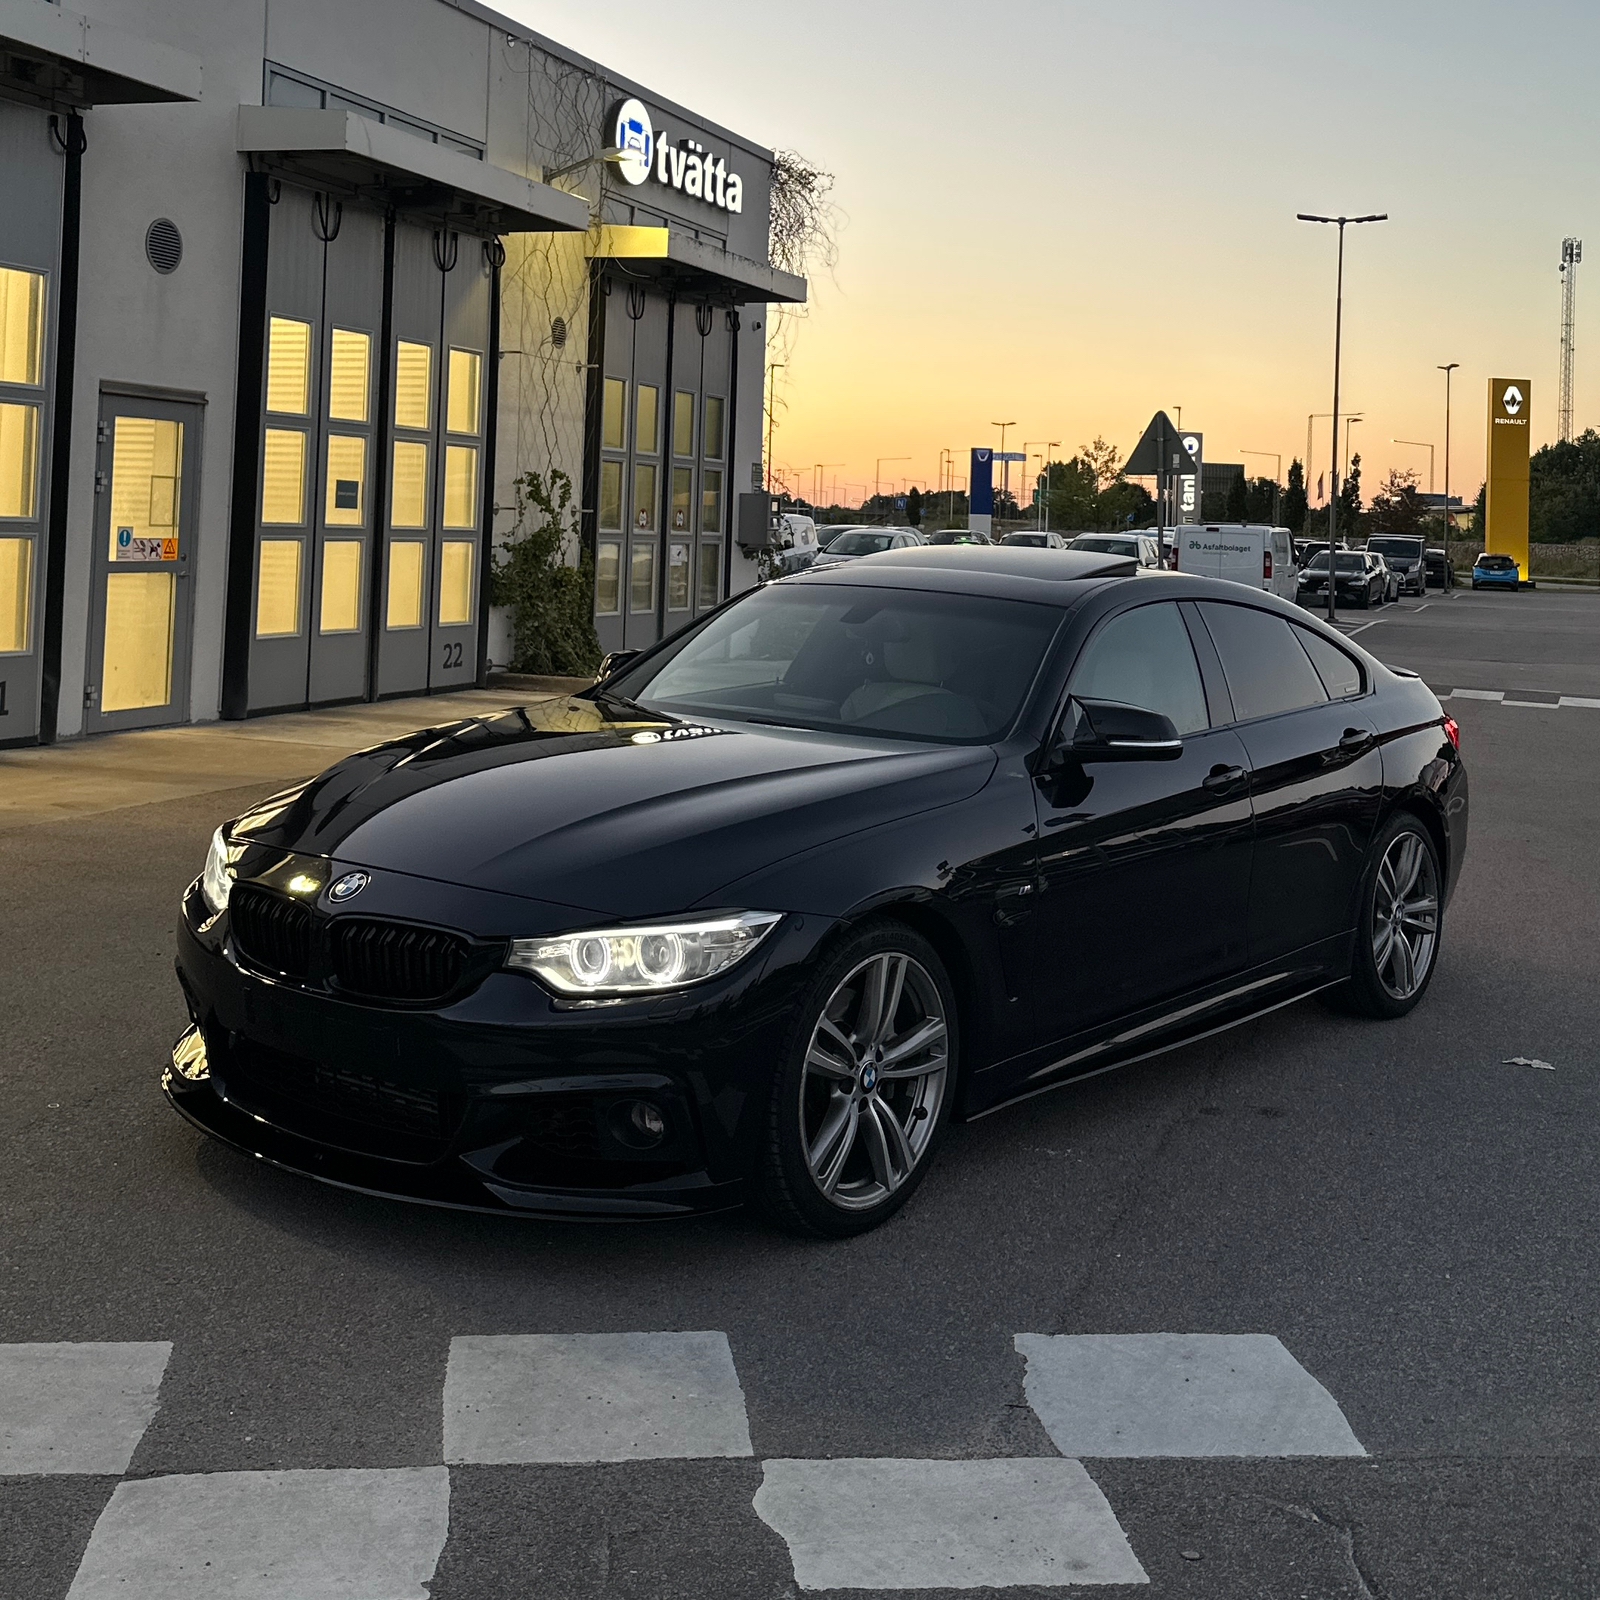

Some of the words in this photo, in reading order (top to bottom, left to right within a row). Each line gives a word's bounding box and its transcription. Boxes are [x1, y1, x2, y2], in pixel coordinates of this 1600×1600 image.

[656, 131, 742, 213] tvätta
[1180, 456, 1196, 511] tan
[1202, 544, 1251, 553] Asfaltbolaget
[443, 642, 463, 669] 22
